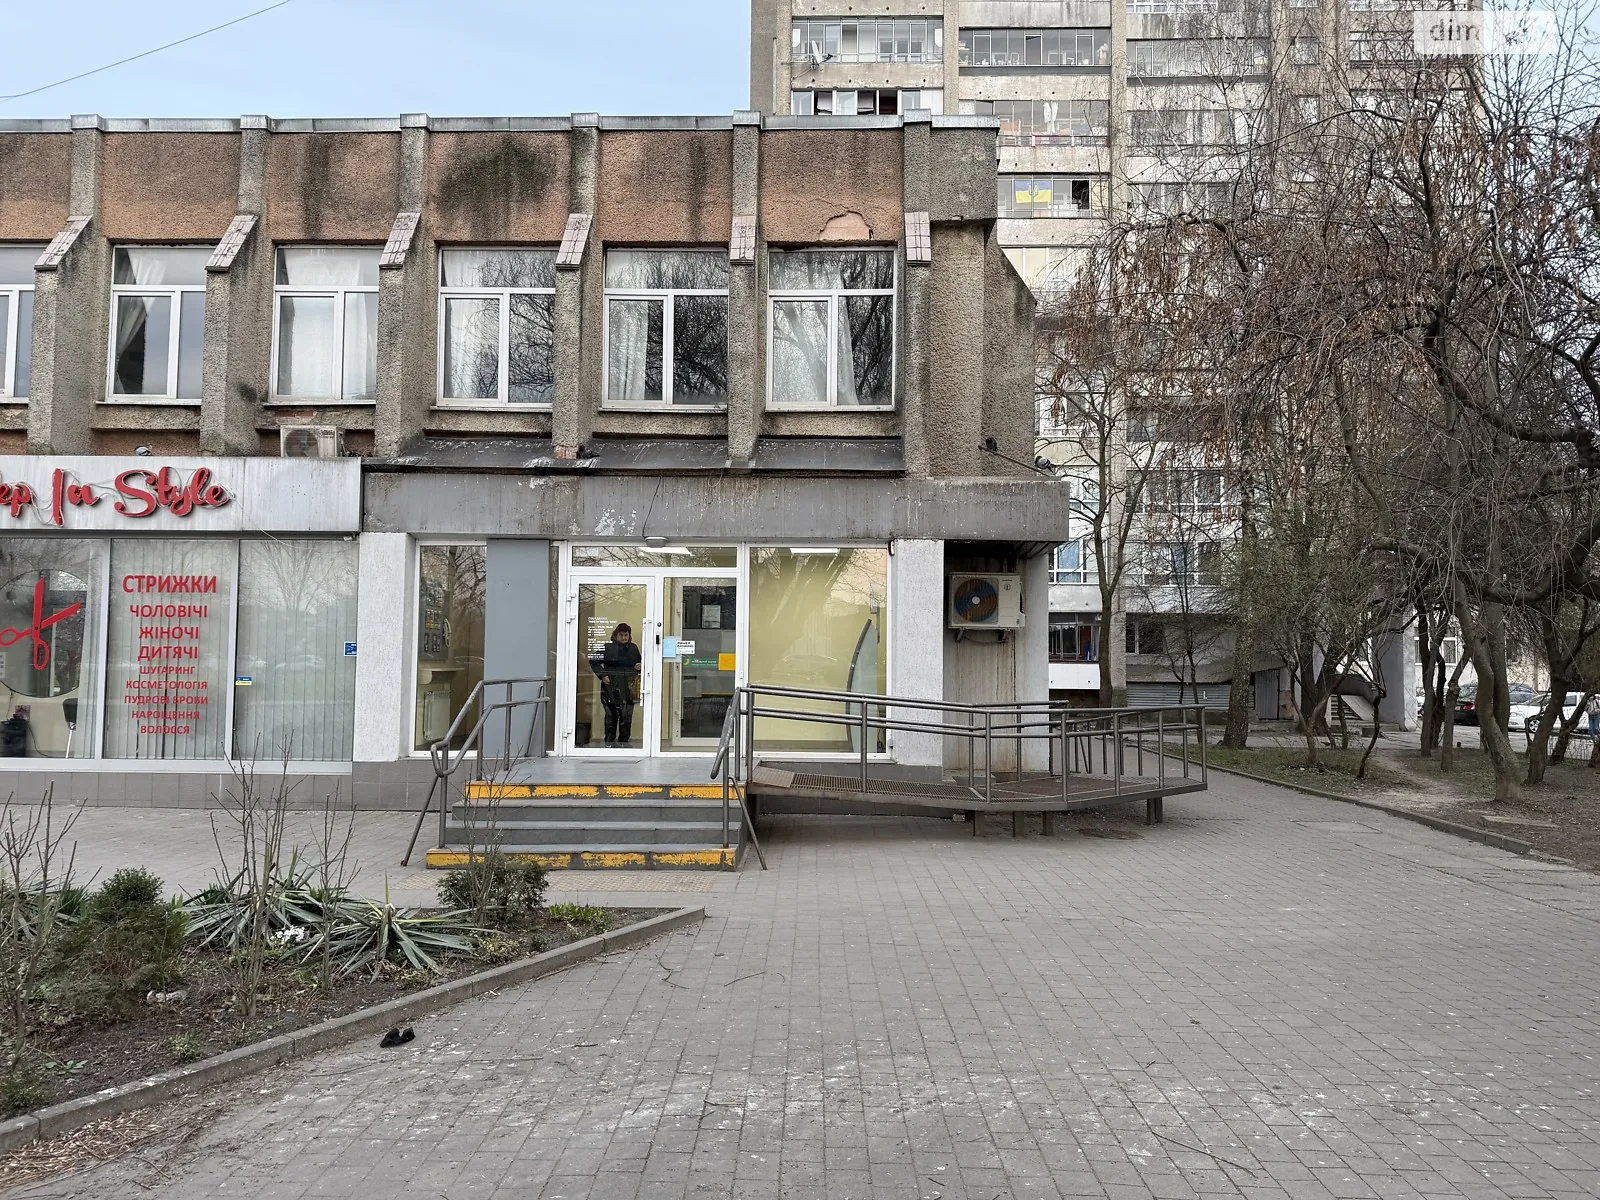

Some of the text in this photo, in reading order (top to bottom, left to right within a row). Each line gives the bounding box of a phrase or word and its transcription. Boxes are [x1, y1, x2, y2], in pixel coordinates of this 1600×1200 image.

[114, 466, 229, 517] Style
[123, 575, 217, 594] СТРИЖКИ
[130, 605, 208, 619] ЧОЛОВІЧІ
[139, 626, 200, 640] ЖІНОЧІ
[138, 645, 199, 662] ДИТЯЧІ
[140, 666, 194, 675] ШУГАРИНГ
[126, 680, 208, 690] КОСМЕТОЛОГІЯ
[124, 696, 170, 705] ПУДРОВІ
[132, 710, 200, 721] НАРОЩЕННЯ
[141, 725, 190, 734] ВОЛОССЯ
